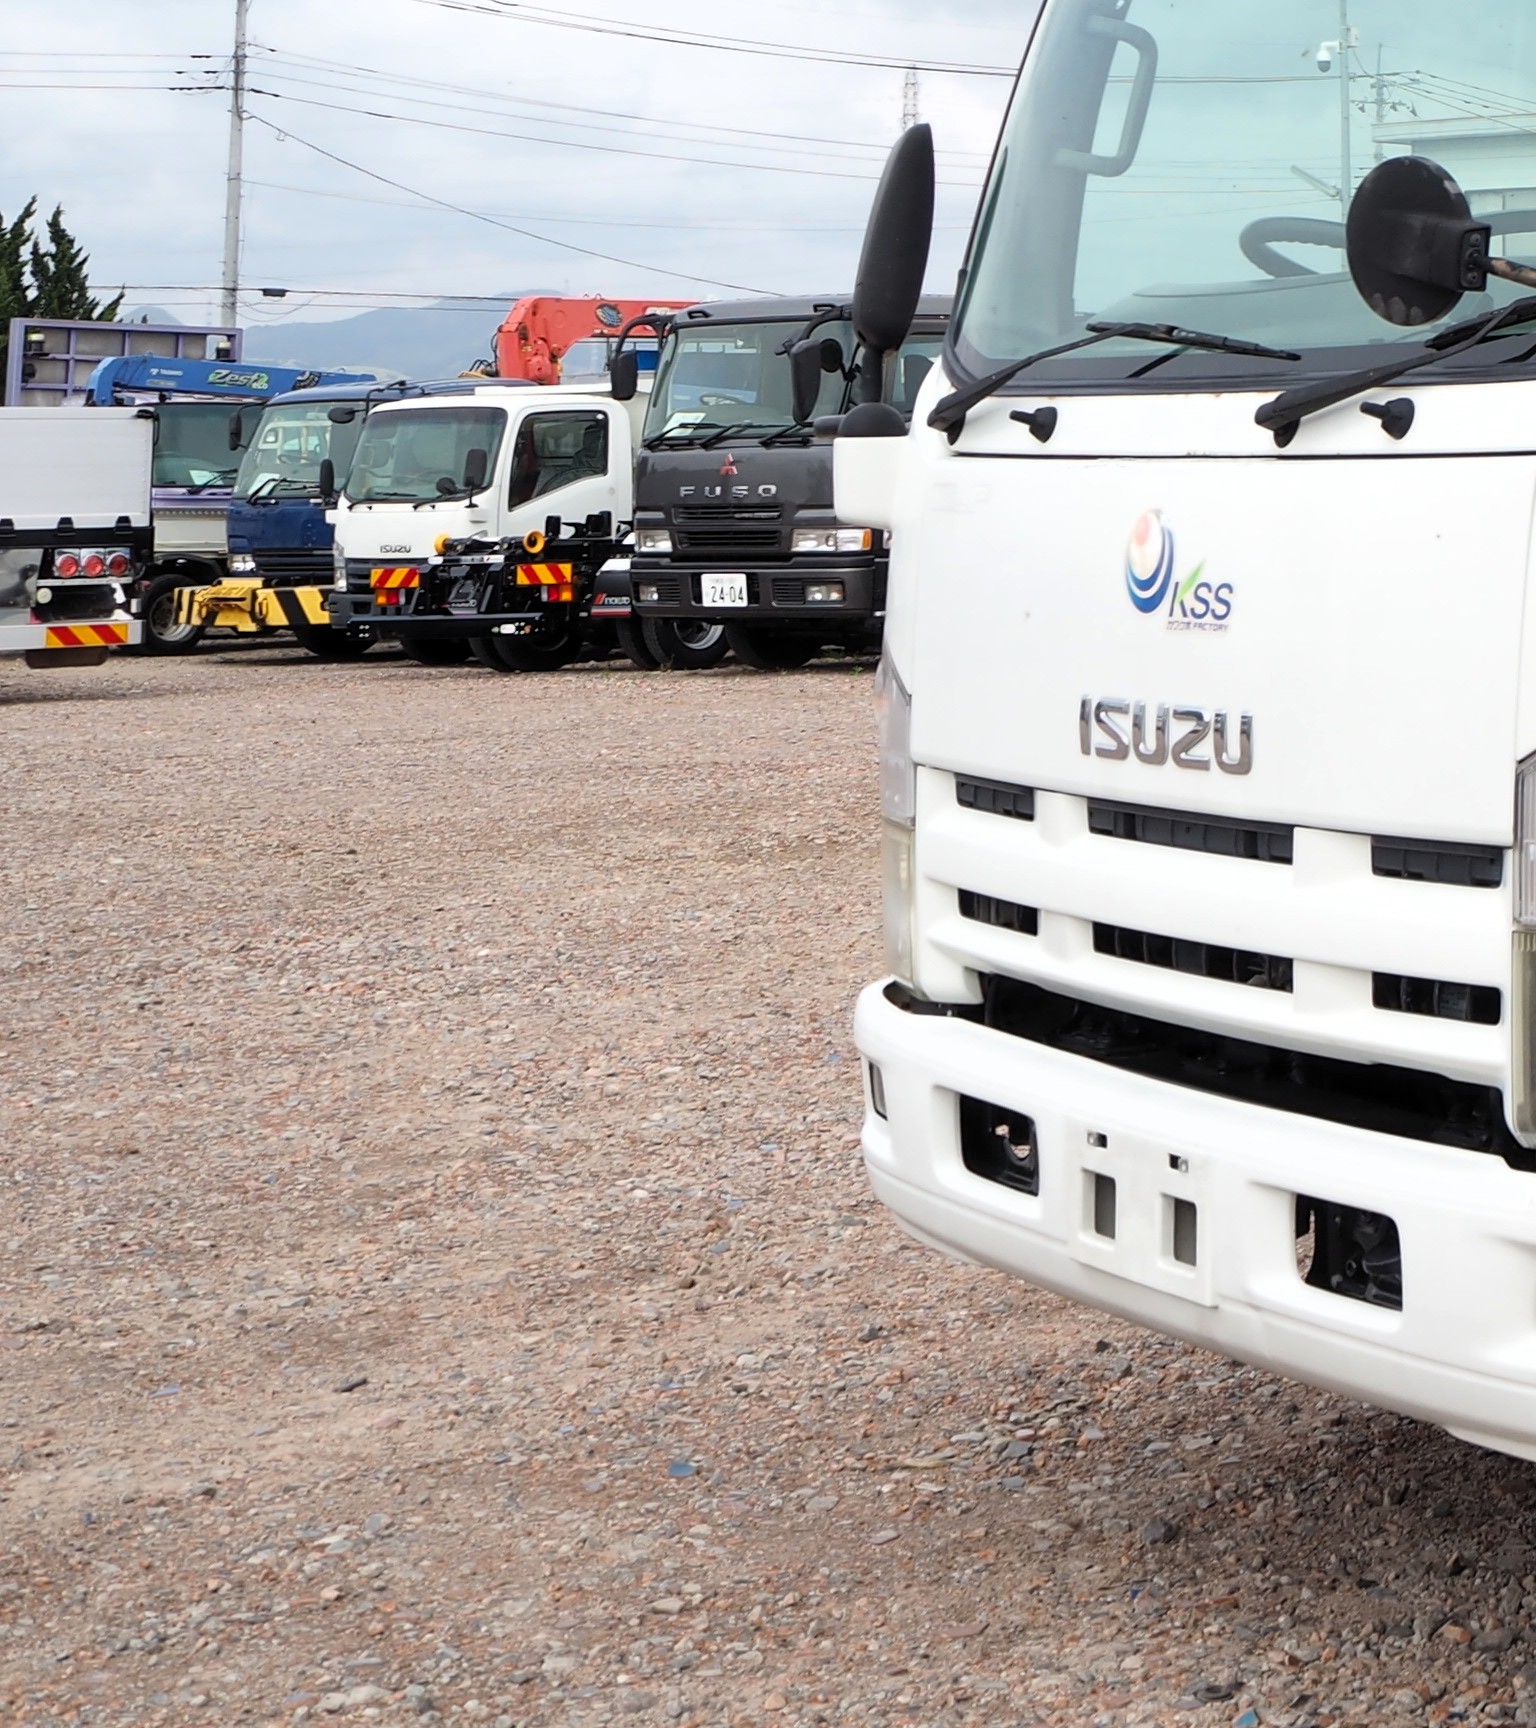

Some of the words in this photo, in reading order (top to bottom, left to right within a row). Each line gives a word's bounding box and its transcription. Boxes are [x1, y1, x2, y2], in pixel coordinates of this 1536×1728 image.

[679, 484, 778, 498] FUSO
[380, 544, 412, 554] ISUZU
[710, 585, 745, 604] 24-04
[1168, 564, 1235, 622] KSS
[1078, 692, 1254, 776] ISUZU
